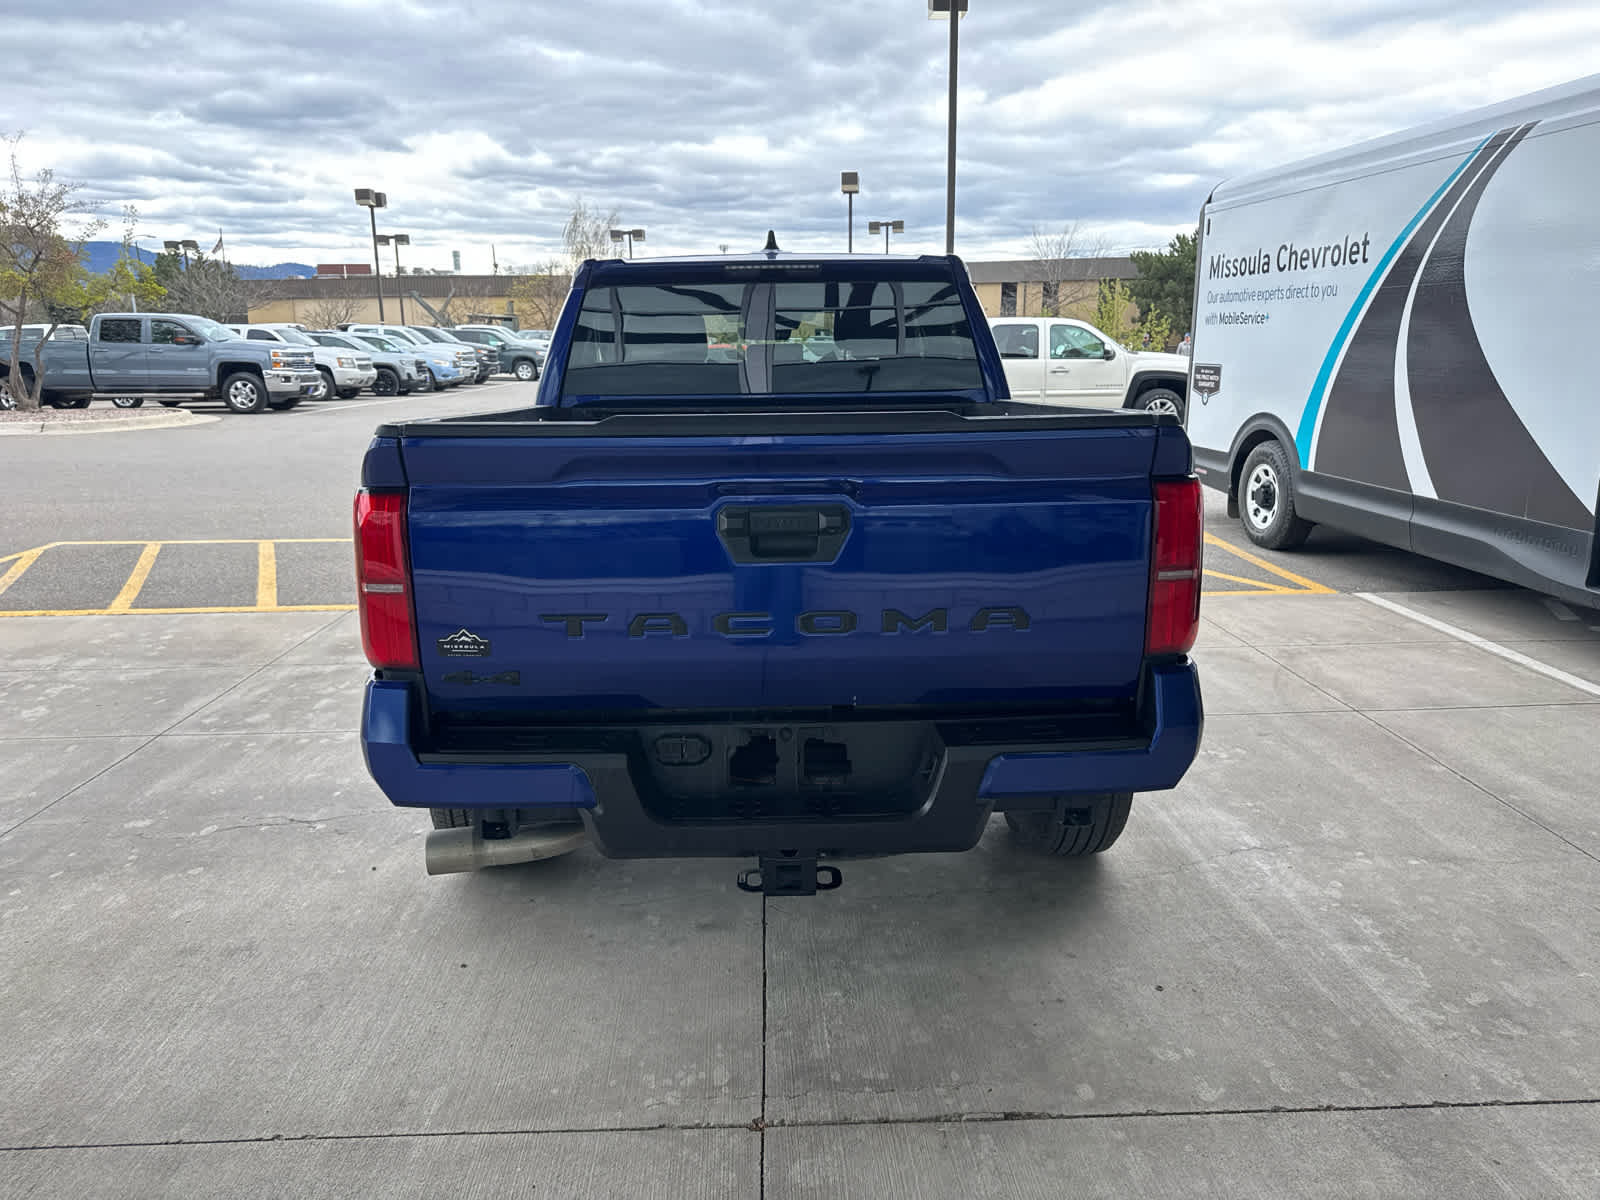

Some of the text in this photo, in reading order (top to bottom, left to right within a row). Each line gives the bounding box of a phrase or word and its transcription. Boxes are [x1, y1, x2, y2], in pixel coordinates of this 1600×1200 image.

[1209, 231, 1370, 280] Missoula Chevrolet
[1207, 282, 1338, 304] Our automotive experts direct to you
[1205, 311, 1218, 325] with
[538, 605, 1032, 640] TACOMA
